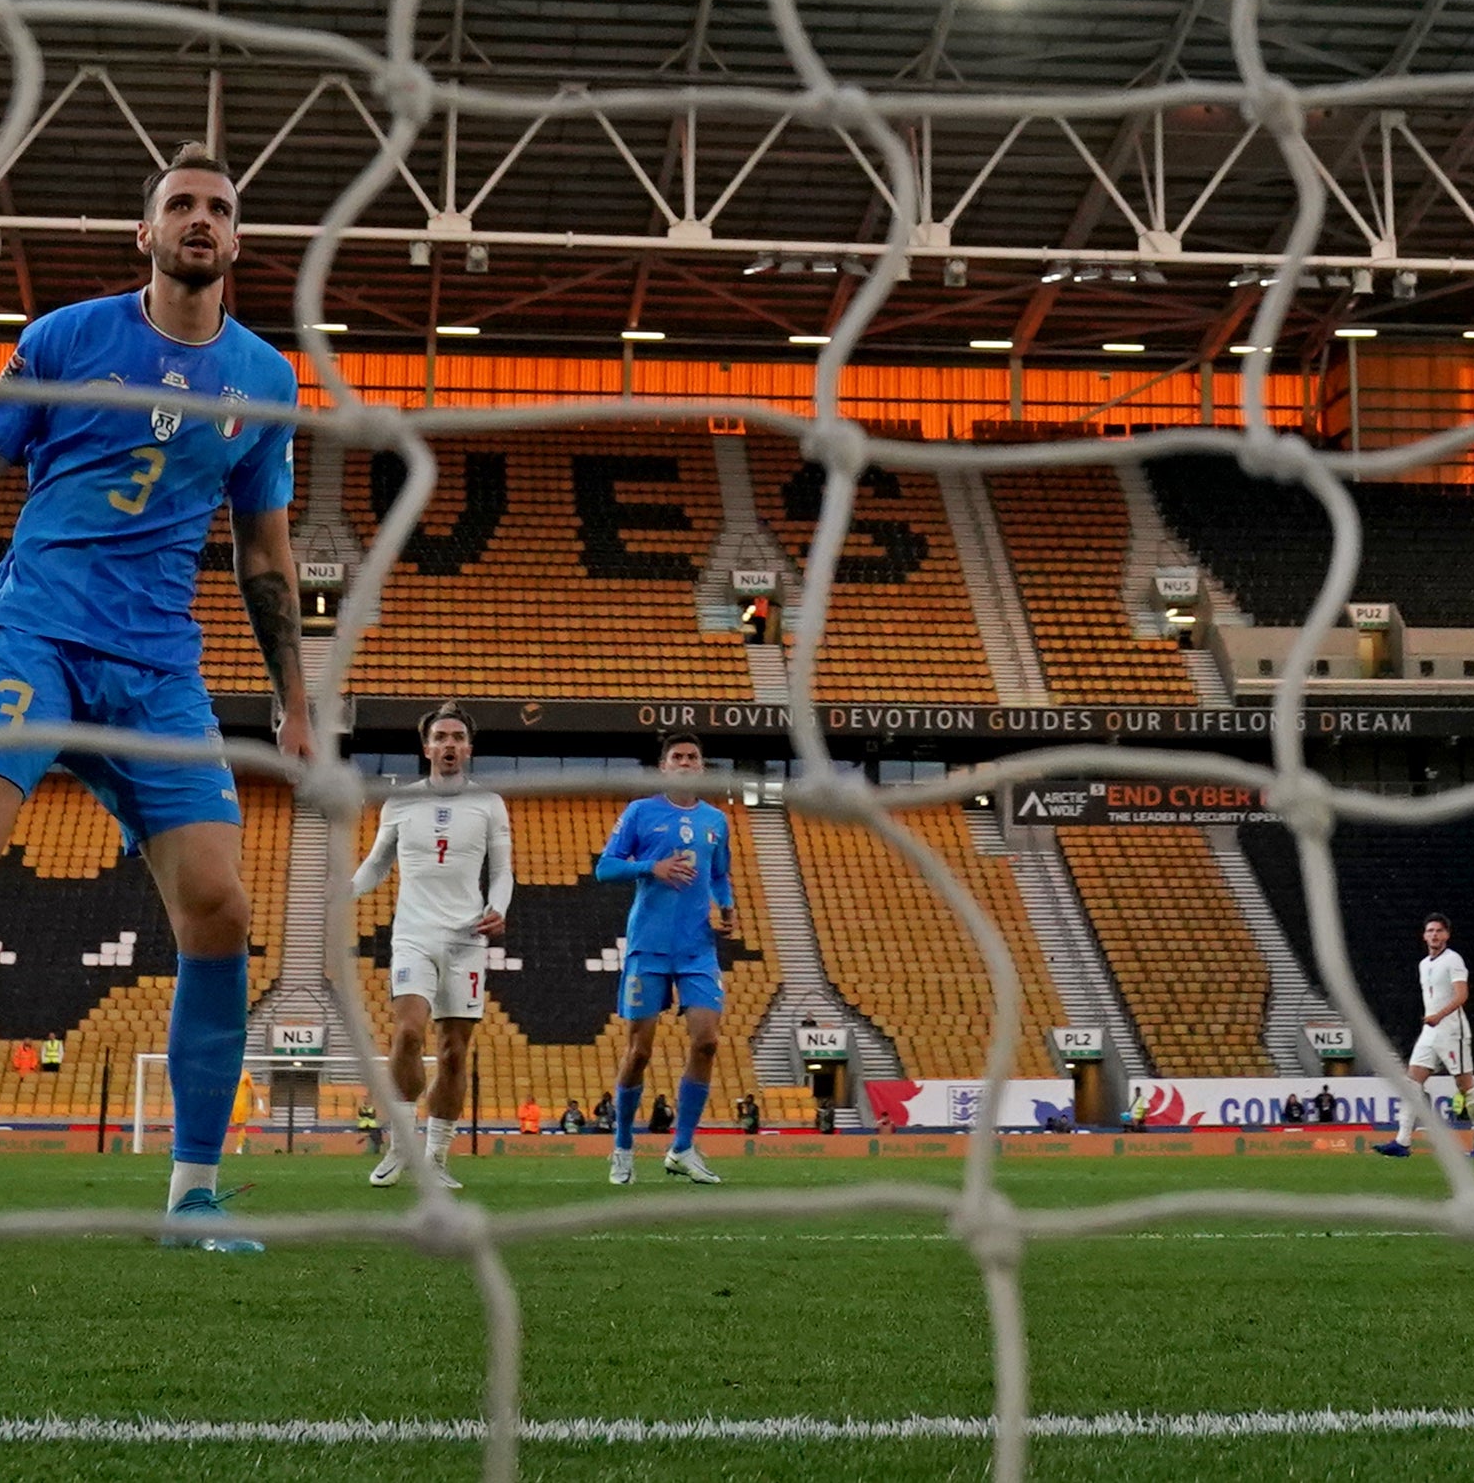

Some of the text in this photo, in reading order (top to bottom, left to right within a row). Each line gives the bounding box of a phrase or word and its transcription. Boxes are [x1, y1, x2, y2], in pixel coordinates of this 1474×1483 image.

[107, 446, 166, 516] 3
[307, 565, 336, 577] NU3
[740, 574, 769, 586] NU4
[1163, 580, 1191, 592] NU5
[1356, 607, 1381, 619] PU2
[639, 705, 696, 726] OUR
[710, 706, 816, 728] LOVIN
[829, 708, 974, 730] DEVOTION
[988, 710, 1093, 731] GUIDES
[1106, 711, 1161, 731] OUR
[1320, 712, 1412, 733] DREAM
[1042, 791, 1088, 804] ARCTIC
[1107, 785, 1163, 807] END
[1169, 785, 1252, 807] CYBER
[1049, 804, 1084, 817] WOLF
[1108, 811, 1132, 822] THE
[1133, 811, 1178, 822] LEADER
[1179, 812, 1192, 822] IN
[1193, 812, 1248, 823] SECURITY
[436, 839, 449, 864] 7
[469, 971, 479, 999] 7
[283, 1030, 314, 1044] NL3
[806, 1033, 837, 1046] NL4
[1064, 1032, 1092, 1046] PL2
[1314, 1031, 1344, 1045] NL5
[1335, 1097, 1377, 1124] ON
